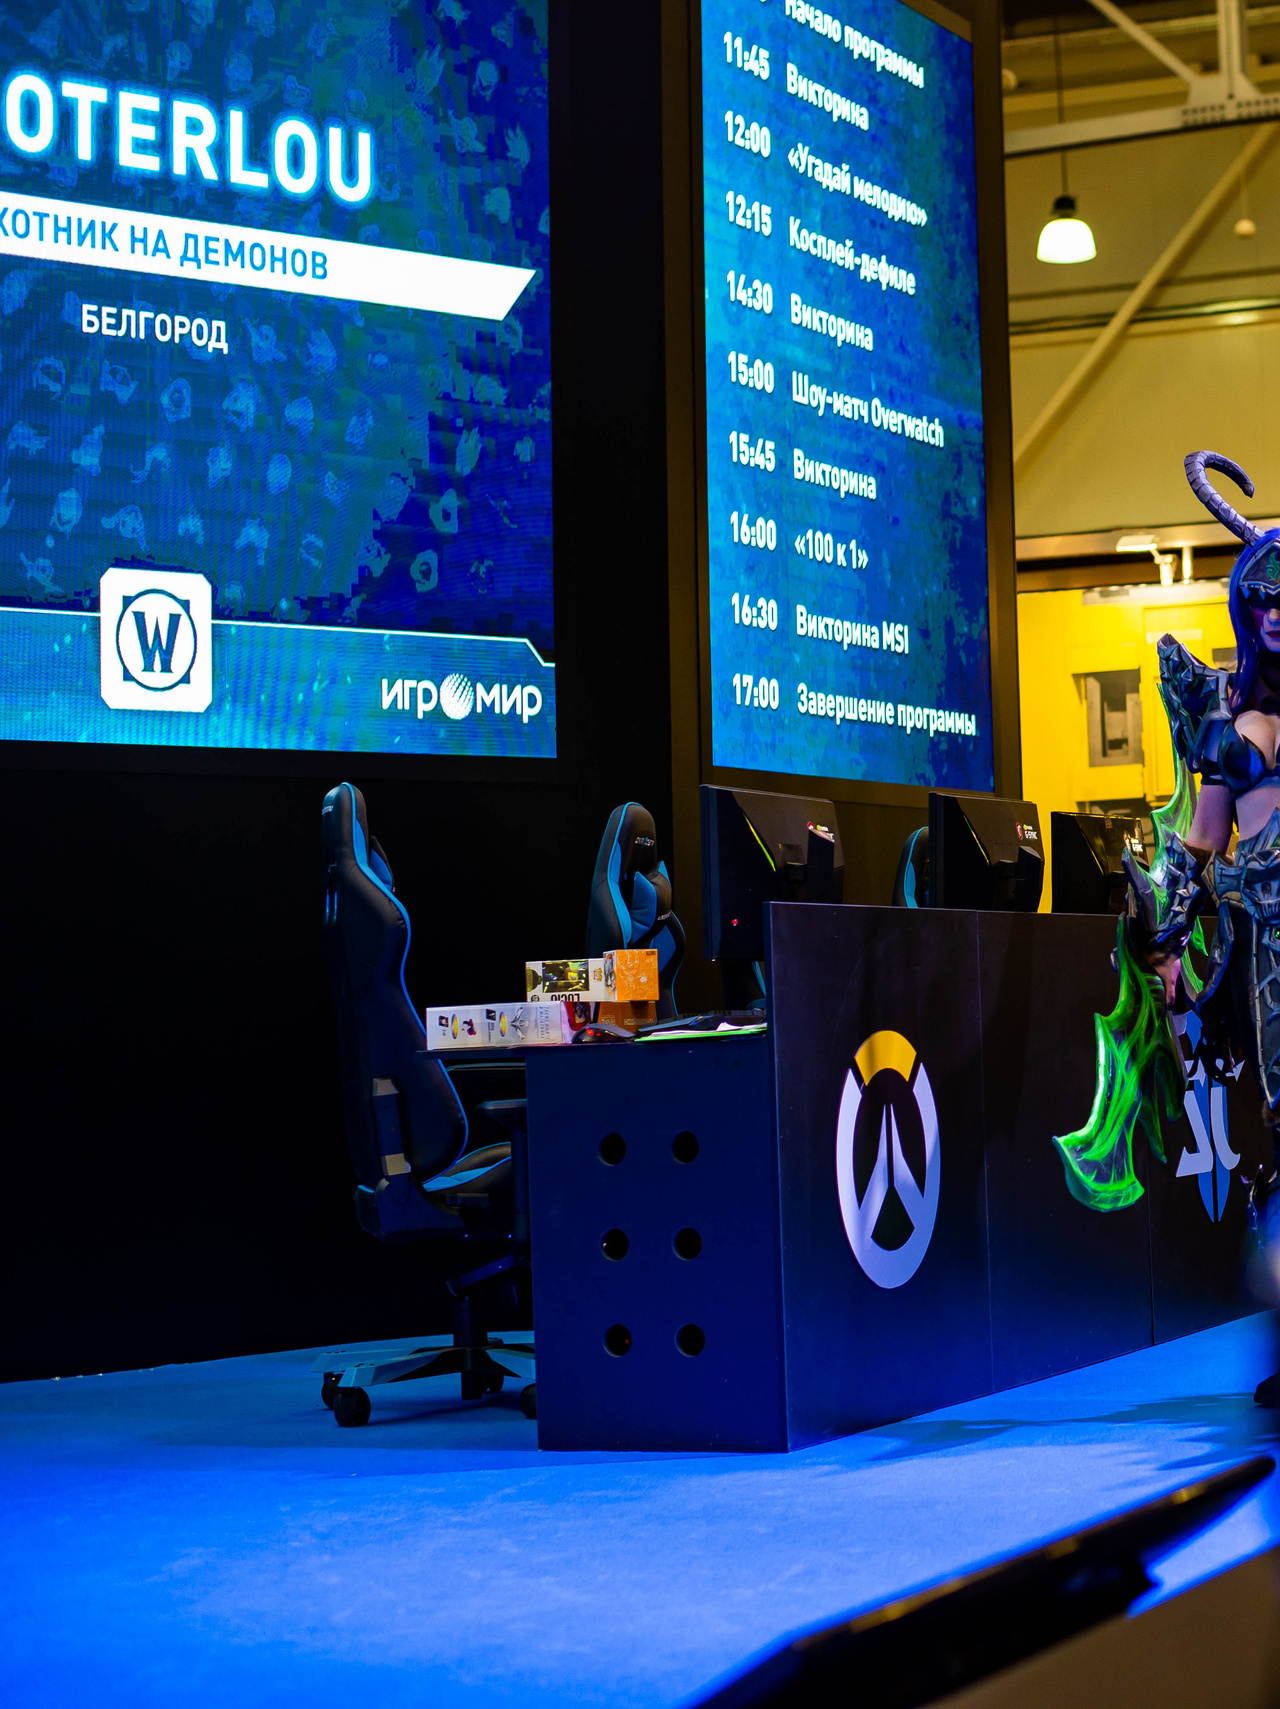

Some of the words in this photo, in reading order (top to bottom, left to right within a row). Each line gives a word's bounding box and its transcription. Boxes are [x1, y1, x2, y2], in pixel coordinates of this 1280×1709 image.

[724, 32, 769, 79] 11:45
[787, 63, 868, 130] Викторина
[786, 0, 841, 41] Начало
[845, 26, 923, 88] программы
[5, 73, 372, 203] OTERLOU
[725, 111, 770, 157] 12:00
[788, 143, 850, 194] «Угадай
[854, 176, 927, 226] мелодию»
[129, 225, 170, 260] НА
[180, 232, 328, 281] ДЕМОНОВ
[726, 191, 771, 235] 12:15
[789, 216, 916, 296] Косплей-дефиле
[82, 304, 228, 354] БЕЛГОРОД
[727, 270, 772, 313] 14:30
[791, 293, 872, 350] Викторина
[728, 351, 774, 393] 15:00
[793, 371, 868, 423] Шоу-матч
[872, 398, 943, 447] Overwatch
[730, 431, 775, 471] 15:45
[794, 449, 876, 499] Викторина
[731, 511, 776, 550] 16:00
[795, 530, 833, 563] «100
[850, 540, 868, 568] 1»
[732, 593, 777, 630] 16:30
[797, 605, 879, 650] Викторина
[883, 622, 908, 653] MSI
[733, 674, 779, 709] 17:00
[797, 683, 894, 725] Завершение
[898, 705, 975, 736] программы
